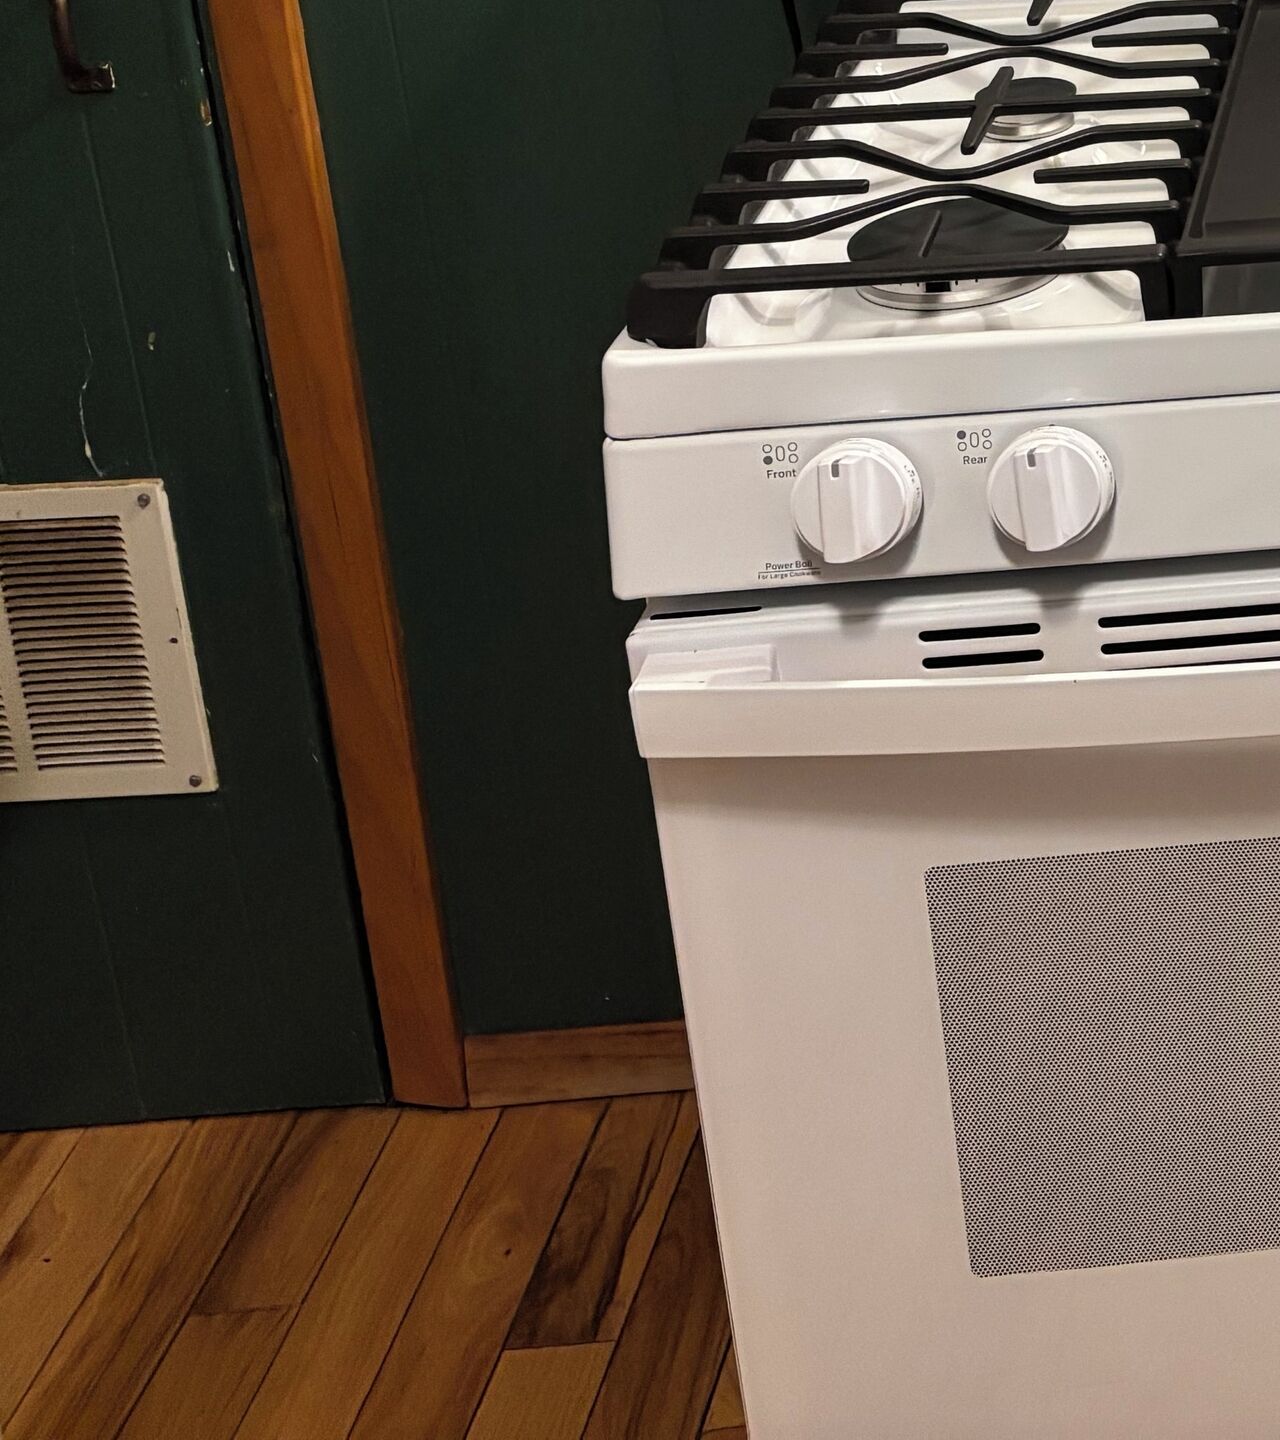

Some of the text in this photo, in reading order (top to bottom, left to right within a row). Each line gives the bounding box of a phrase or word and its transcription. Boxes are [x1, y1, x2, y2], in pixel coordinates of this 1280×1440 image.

[962, 455, 988, 465] Rear
[766, 468, 797, 479] Front
[765, 562, 794, 570] Power
